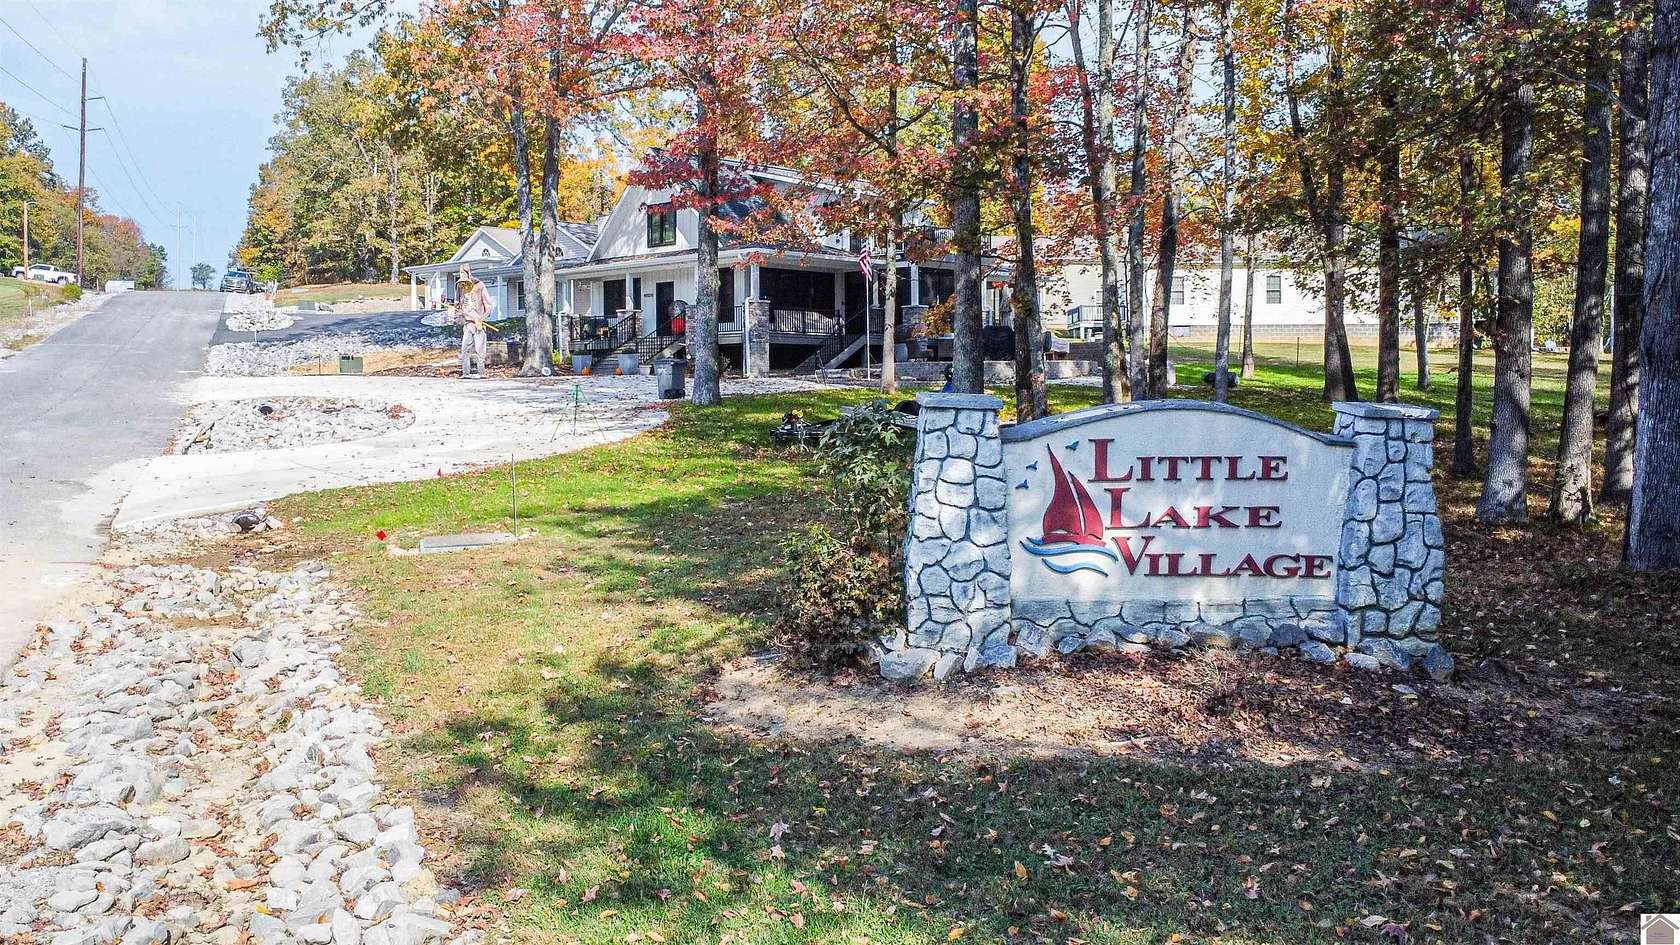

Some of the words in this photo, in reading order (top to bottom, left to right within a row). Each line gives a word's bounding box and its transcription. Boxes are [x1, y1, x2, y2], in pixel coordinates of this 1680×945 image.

[1087, 438, 1289, 482] LITTLE
[1104, 487, 1283, 530] LAKE
[1111, 535, 1334, 578] VILLAGE
